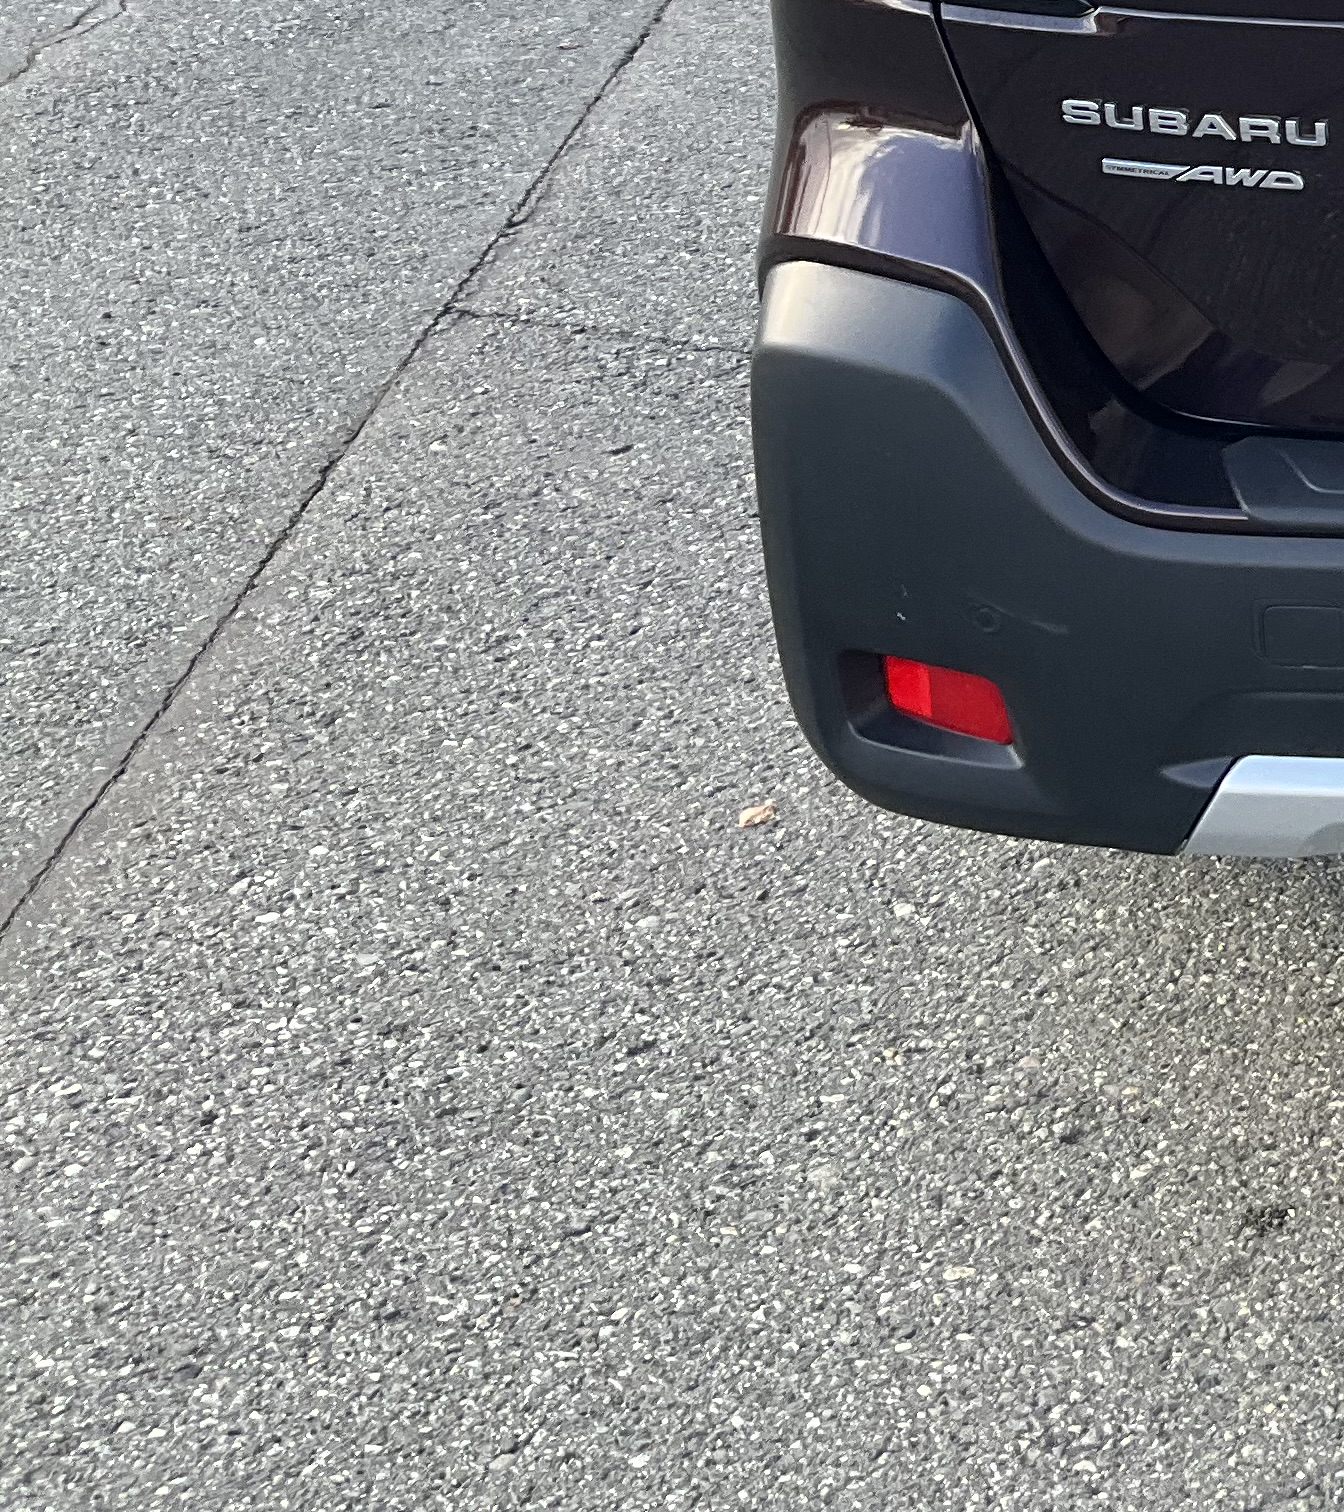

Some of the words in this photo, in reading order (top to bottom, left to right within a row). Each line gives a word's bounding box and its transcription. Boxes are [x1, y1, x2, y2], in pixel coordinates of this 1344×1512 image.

[1062, 98, 1328, 147] SUBARU
[1104, 164, 1170, 176] SYMMETRICAL
[1176, 165, 1305, 190] AWD
